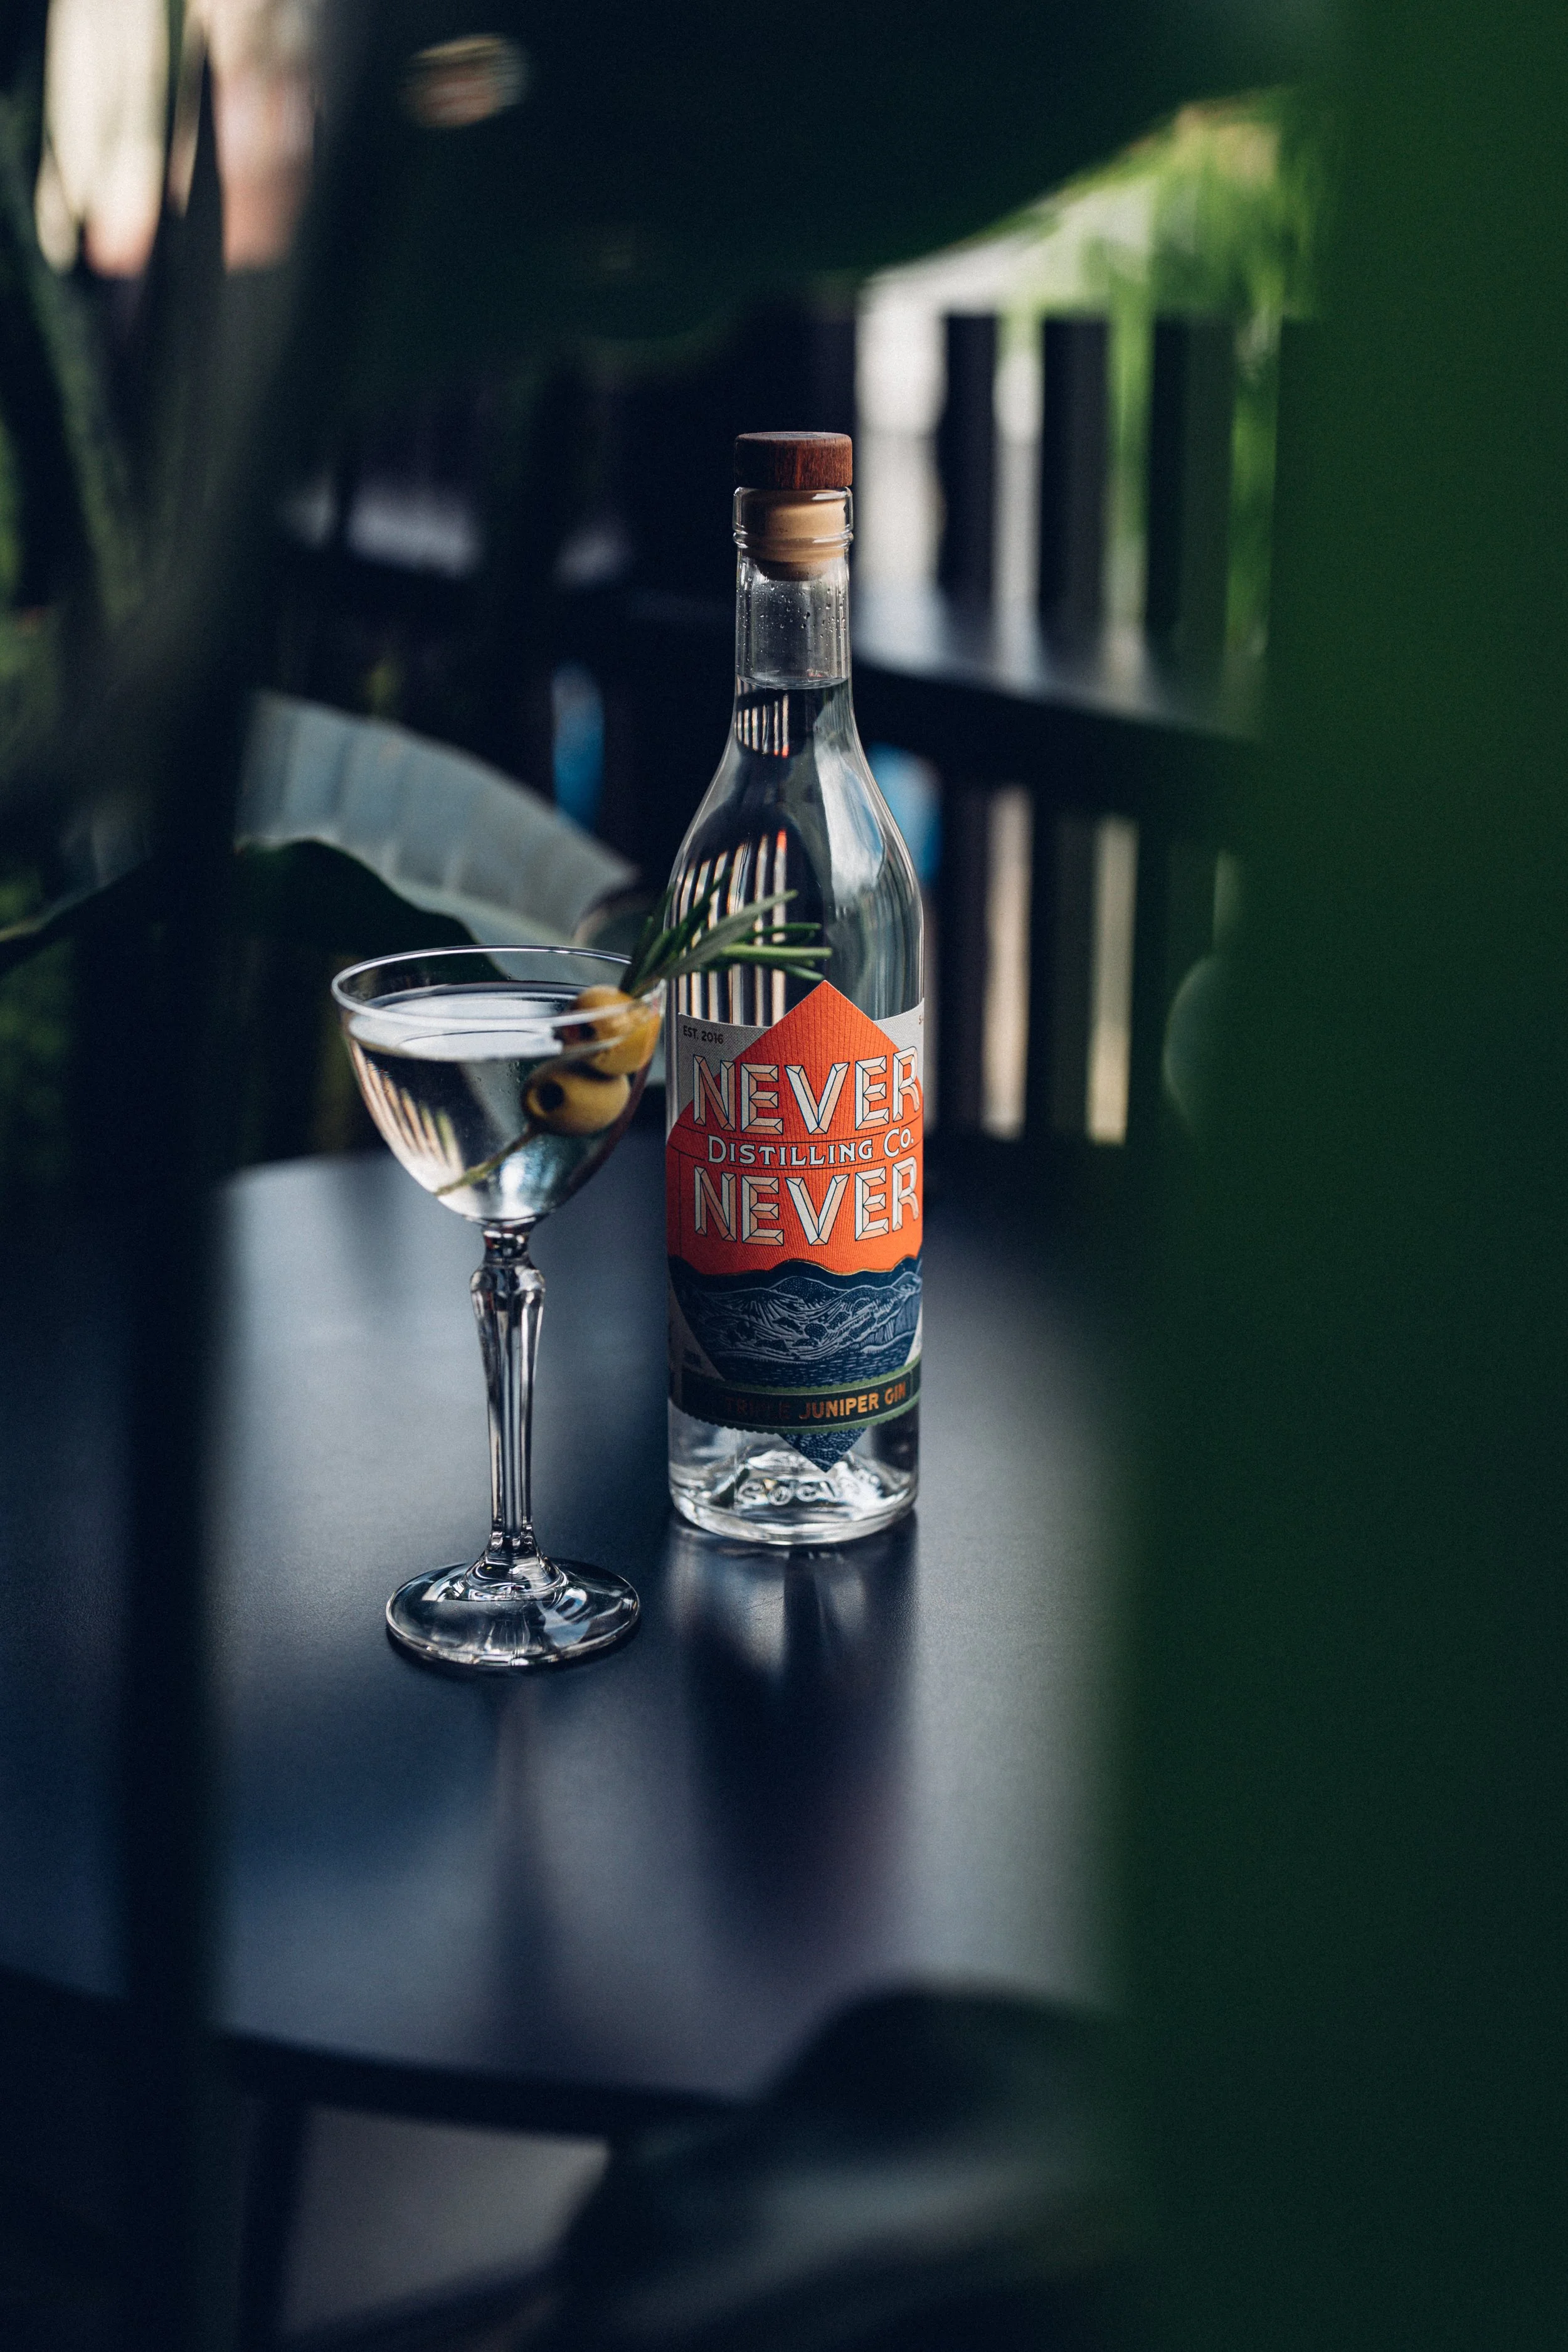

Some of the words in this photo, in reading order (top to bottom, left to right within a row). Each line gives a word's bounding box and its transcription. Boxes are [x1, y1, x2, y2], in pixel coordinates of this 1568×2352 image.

[683, 1025, 699, 1040] EST.
[701, 1030, 724, 1045] 2016
[693, 1046, 920, 1135] NEVER
[694, 1157, 919, 1246] NEVER
[798, 1392, 880, 1420] JUNIPER
[884, 1380, 906, 1405] GIN
